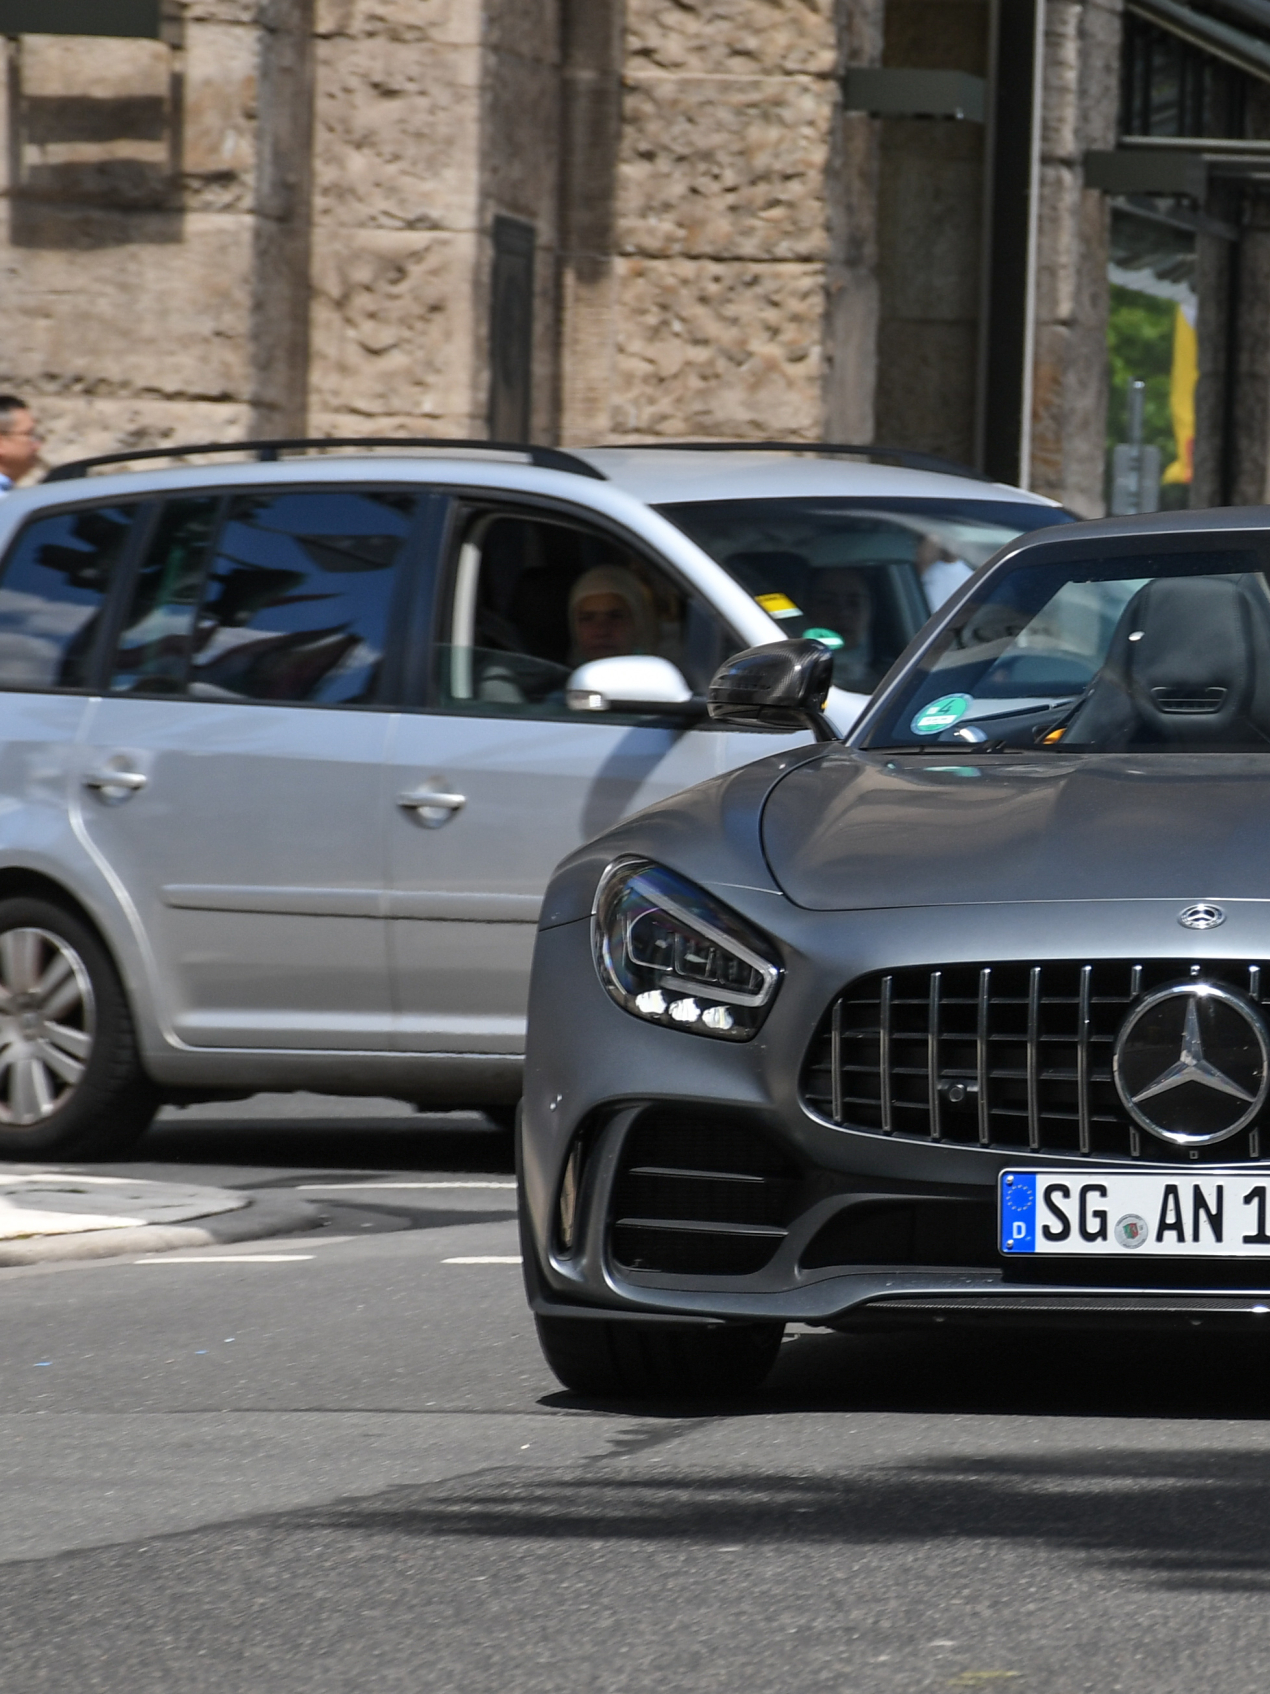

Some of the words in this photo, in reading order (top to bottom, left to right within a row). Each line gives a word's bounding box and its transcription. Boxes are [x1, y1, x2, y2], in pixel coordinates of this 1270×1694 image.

[1012, 1221, 1026, 1239] D
[1042, 1183, 1108, 1243] SG
[1155, 1184, 1224, 1243] AN
